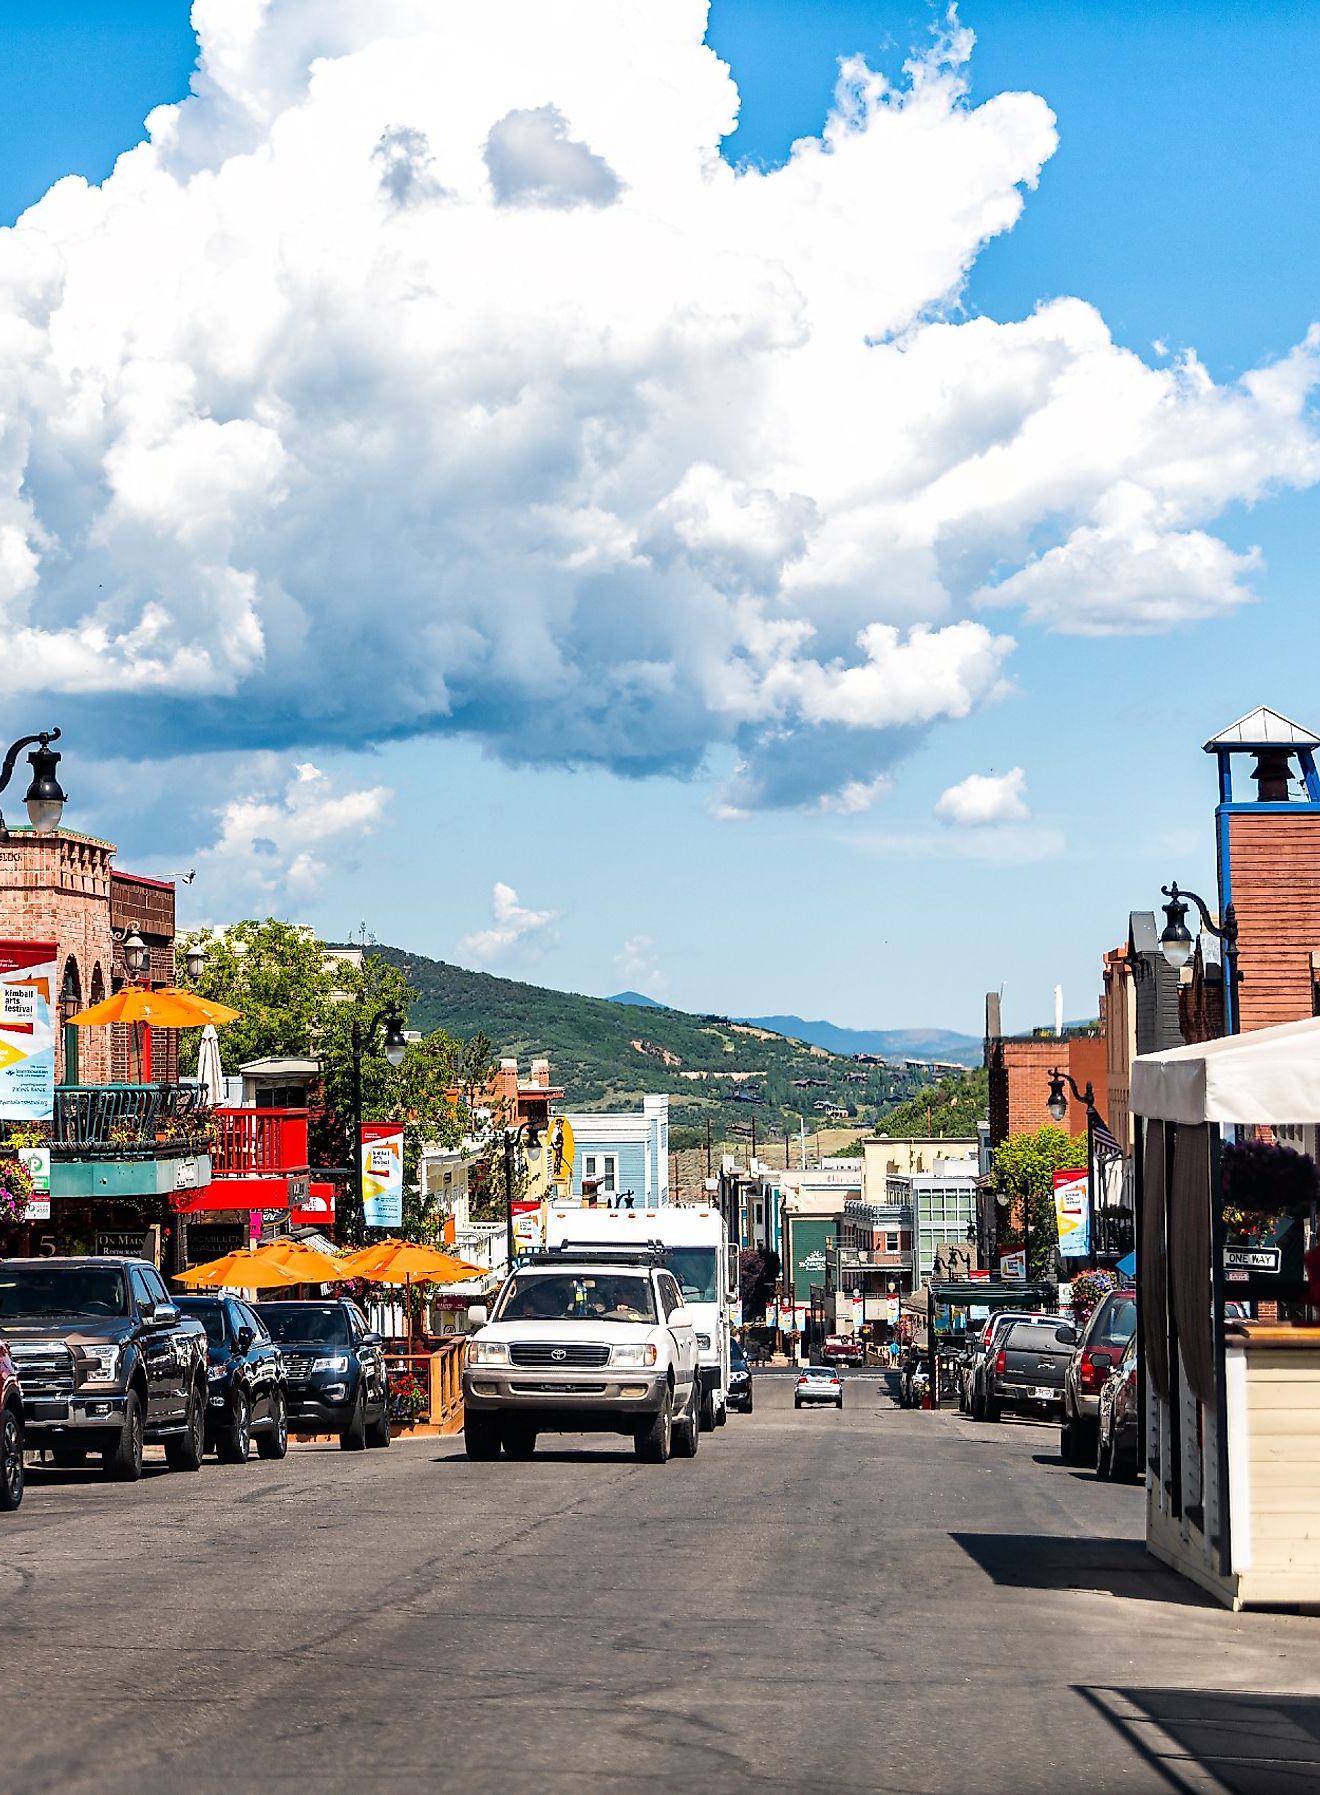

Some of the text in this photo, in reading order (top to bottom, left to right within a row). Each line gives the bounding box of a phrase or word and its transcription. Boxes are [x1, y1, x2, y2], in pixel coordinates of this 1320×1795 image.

[4, 989, 34, 998] kimball
[4, 1004, 33, 1013] festival
[118, 1235, 145, 1246] MAIN
[103, 1247, 142, 1256] RESTAURANT
[1229, 1253, 1272, 1265] ONE WAY
